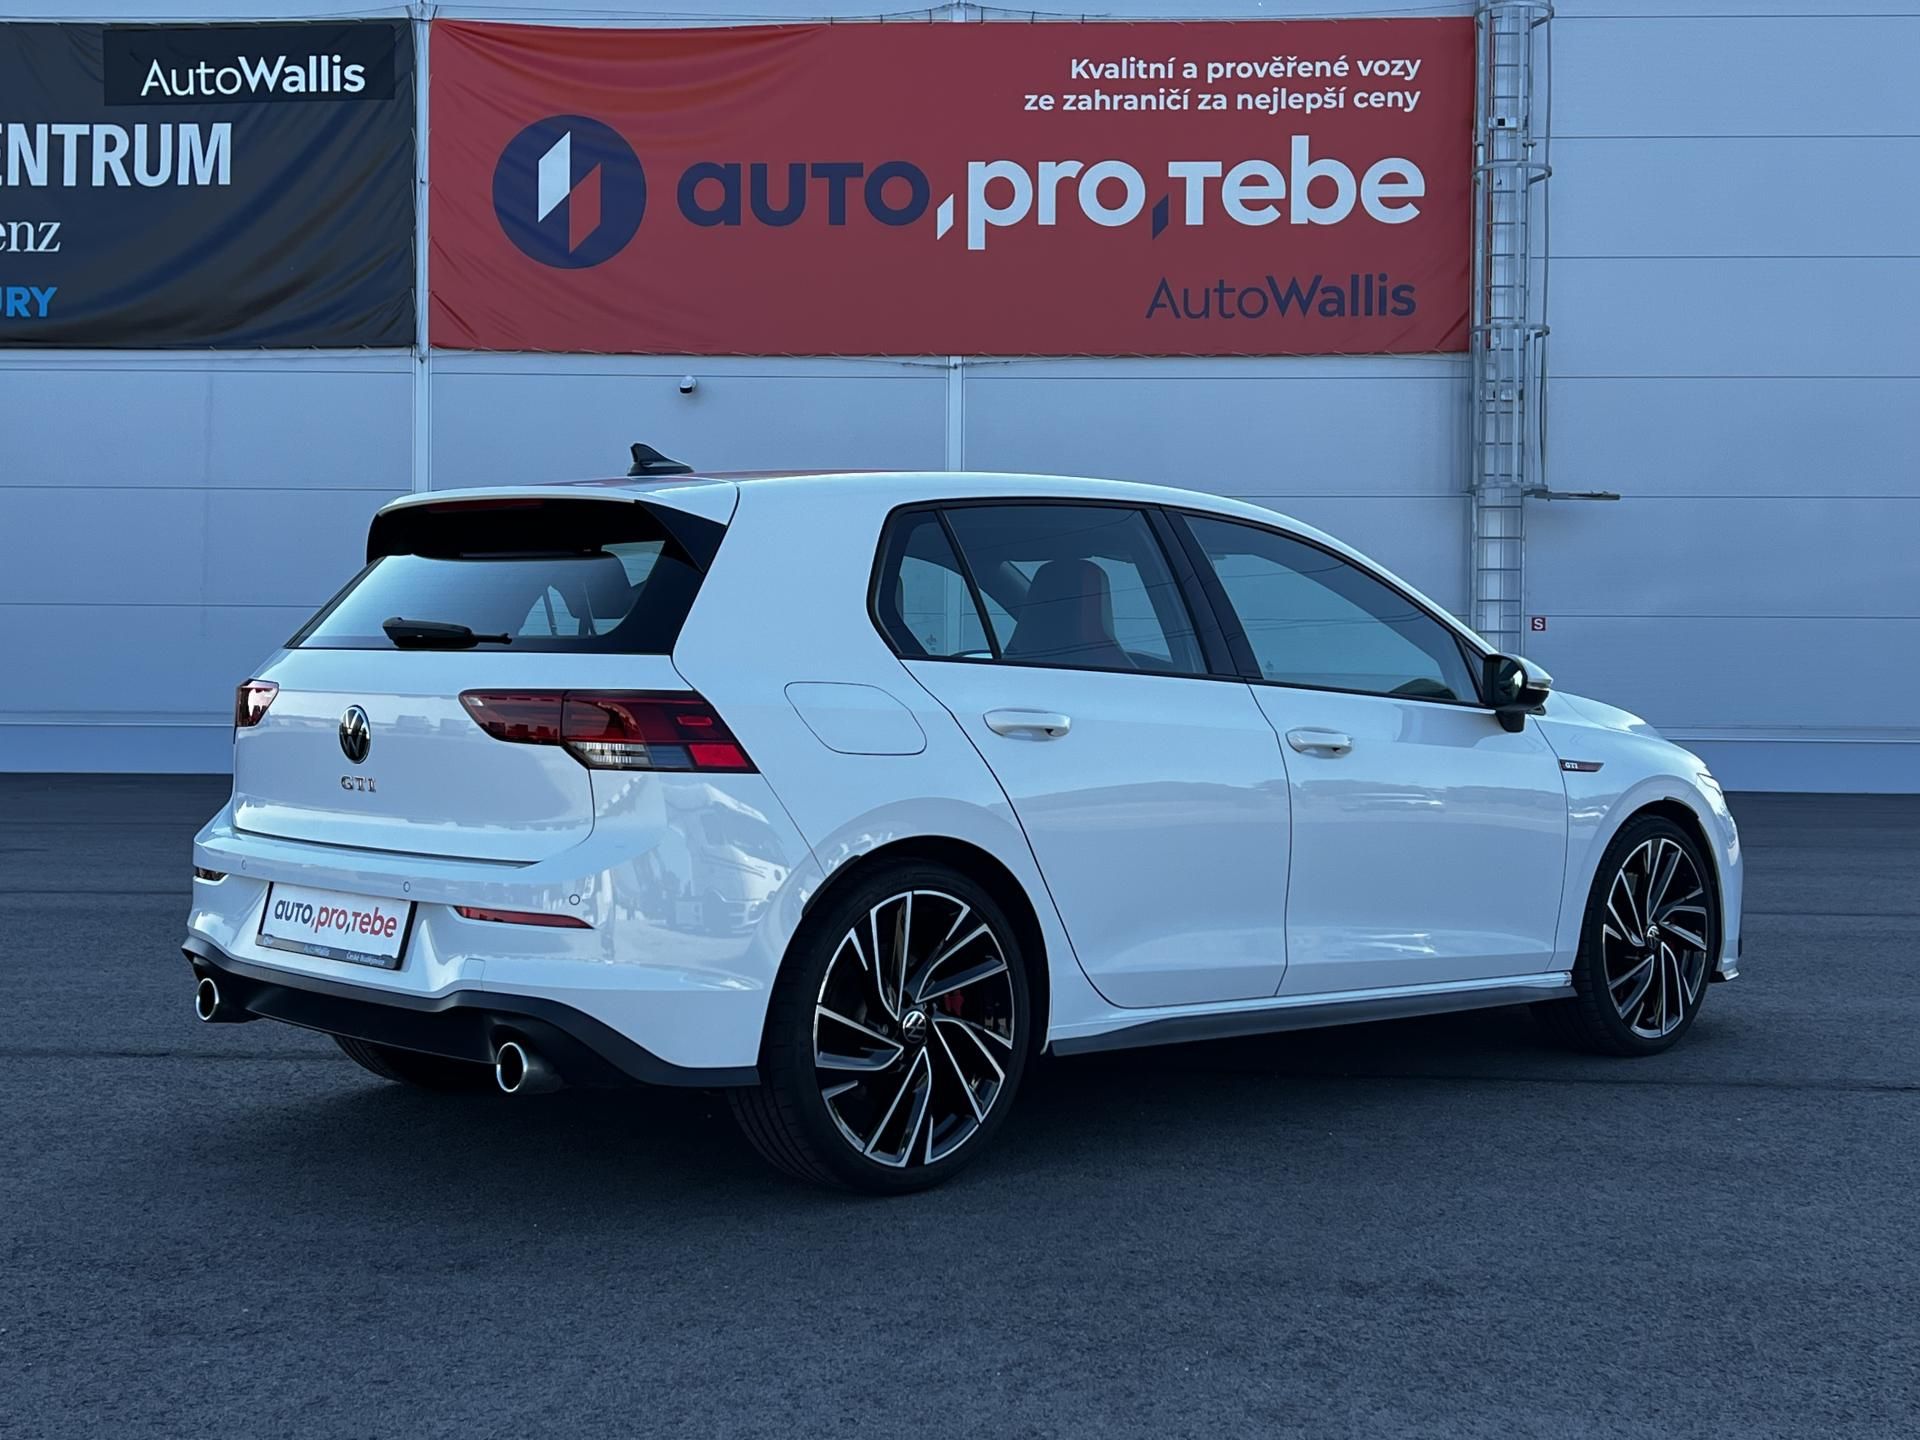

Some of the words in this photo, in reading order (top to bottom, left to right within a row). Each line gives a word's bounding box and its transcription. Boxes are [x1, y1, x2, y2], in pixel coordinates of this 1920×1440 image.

[140, 54, 366, 97] AutoWallis
[1071, 57, 1176, 80] Kvalitní
[1182, 62, 1198, 79] a
[1207, 55, 1350, 83] prověřené
[1356, 59, 1422, 81] vozy
[1024, 94, 1055, 111] ze
[1062, 87, 1192, 111] zahraničí
[1197, 93, 1227, 111] za
[1236, 86, 1347, 114] nejlepší
[1353, 91, 1421, 112] ceny
[0, 122, 232, 187] NTRUM
[0, 286, 57, 317] RY
[1146, 272, 1417, 319] AutoWallis
[1534, 618, 1544, 630] S
[341, 775, 376, 793] GTI
